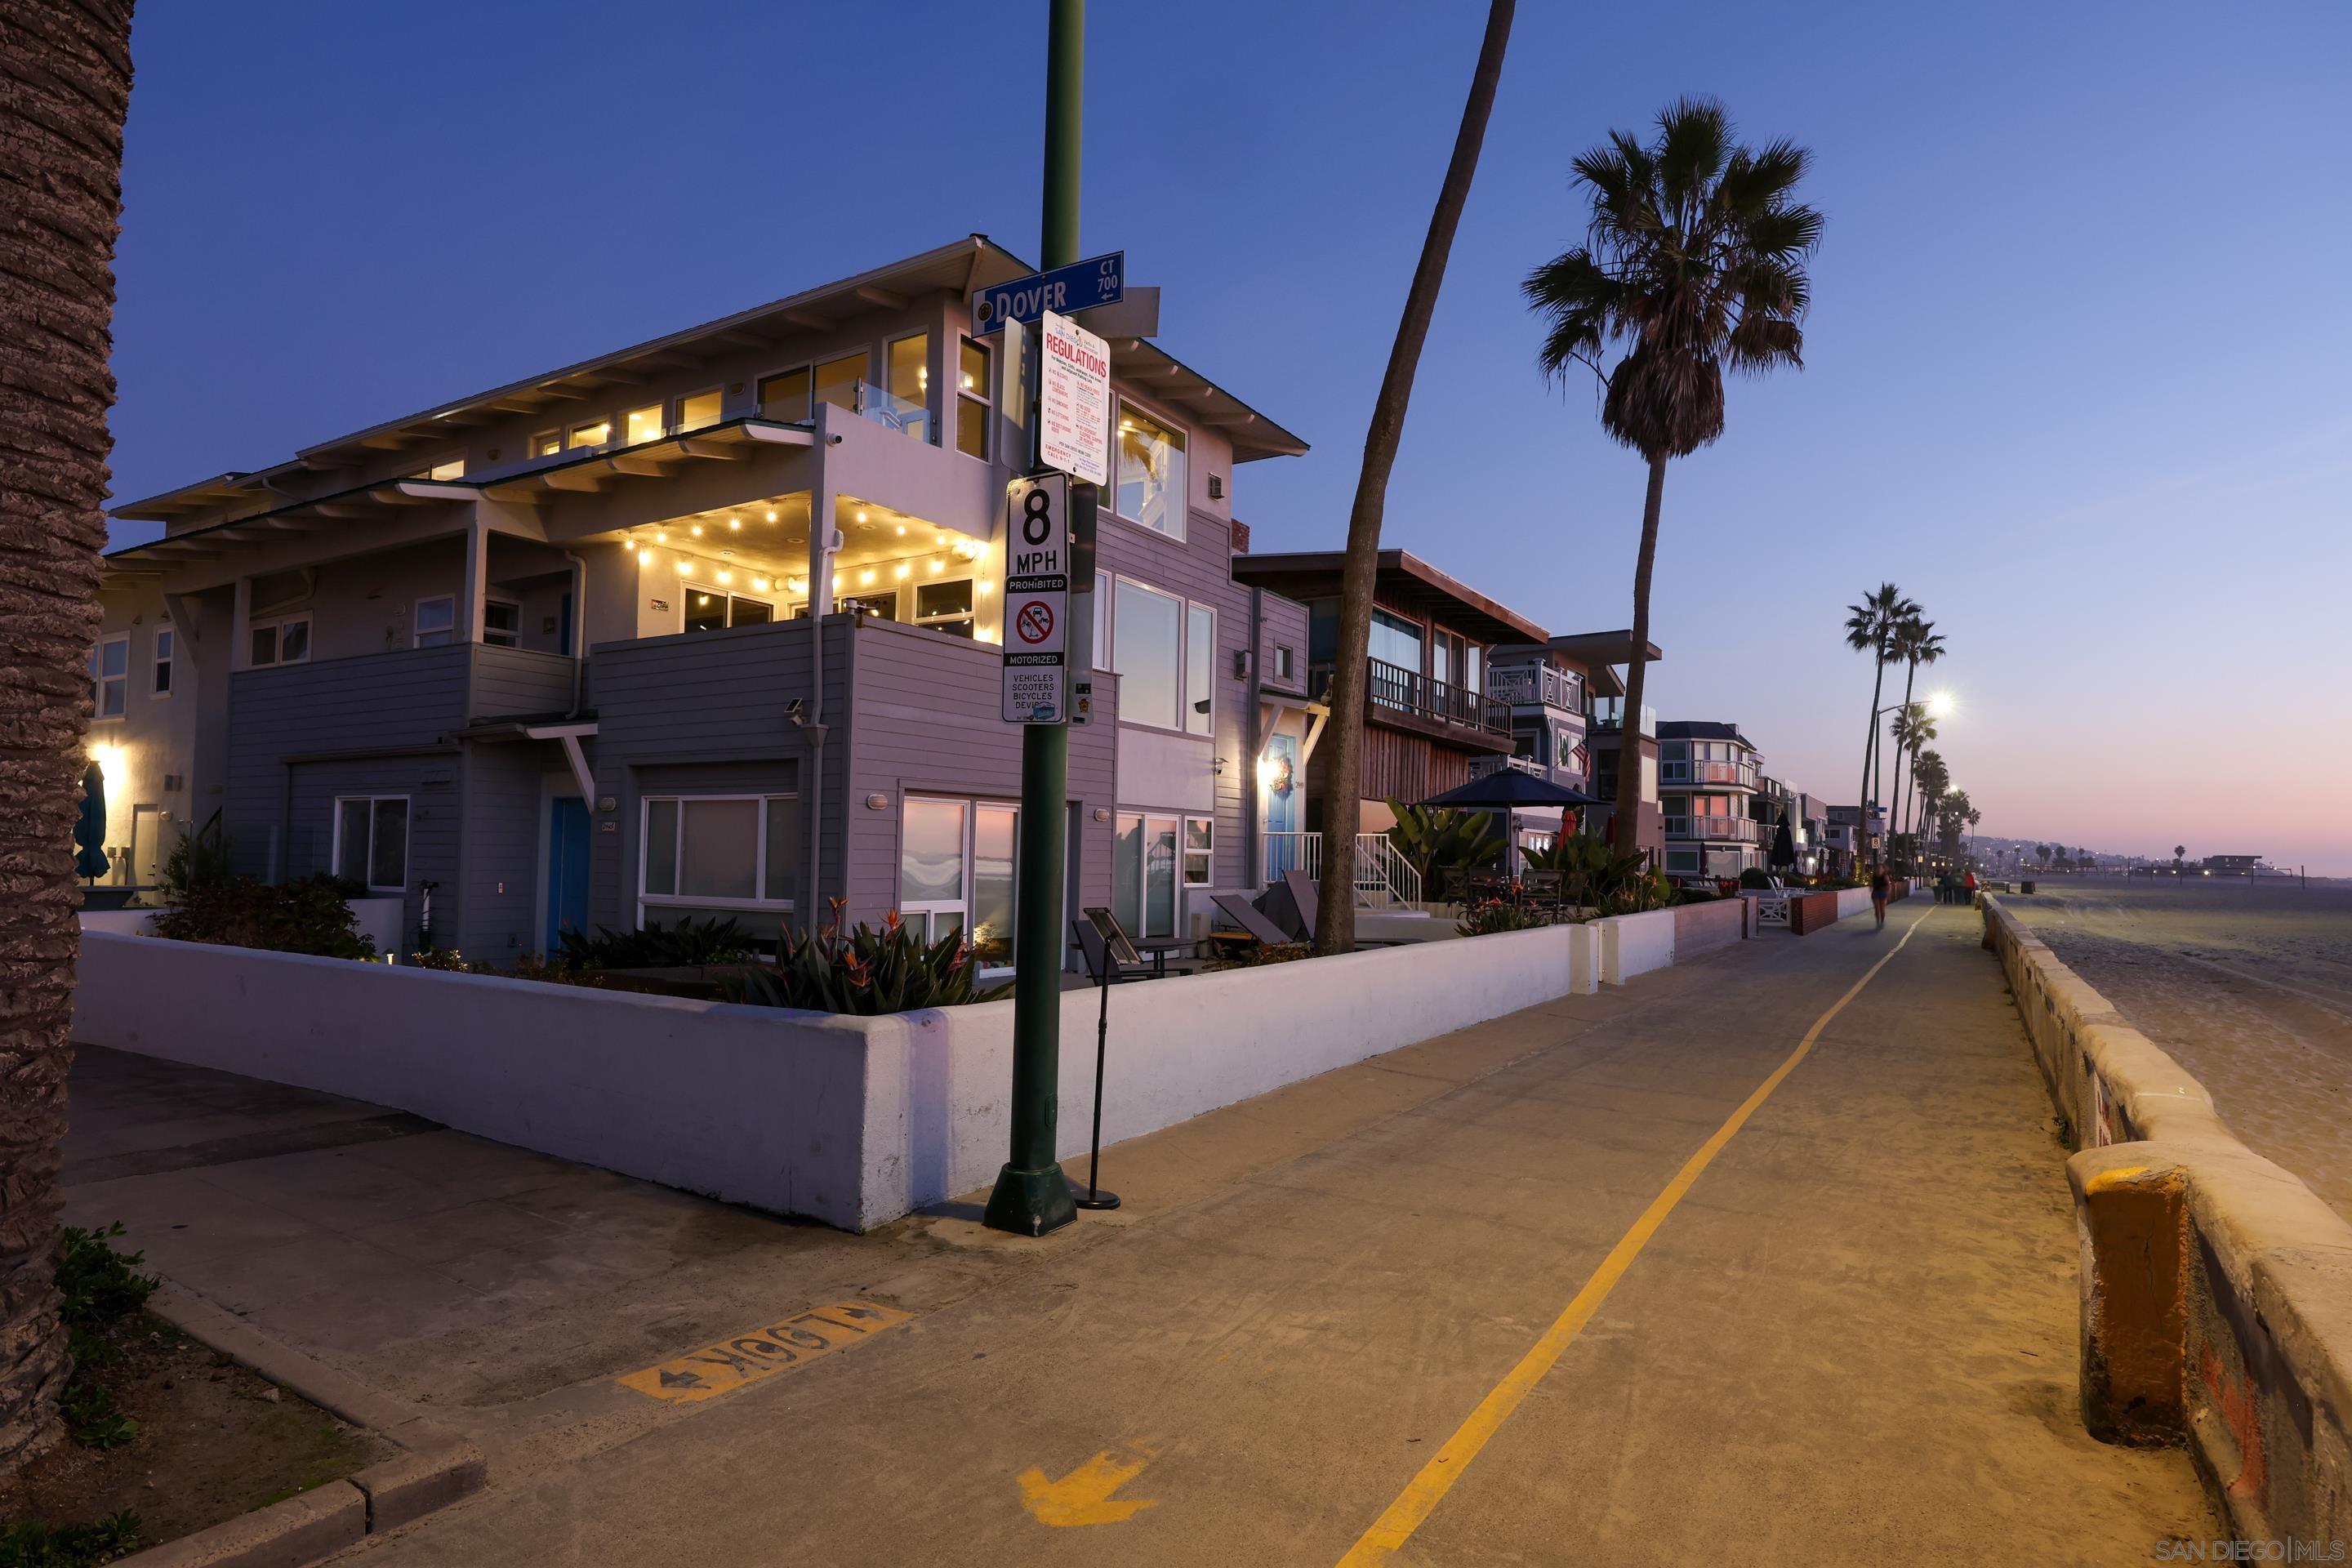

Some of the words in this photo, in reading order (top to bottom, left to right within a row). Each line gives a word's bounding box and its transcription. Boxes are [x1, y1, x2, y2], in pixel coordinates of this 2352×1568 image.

[1100, 259, 1114, 274] CT
[1098, 274, 1118, 292] 700
[996, 281, 1067, 323] DOVER
[1046, 332, 1107, 378] REGULATIONS
[1045, 443, 1071, 458] EMERGENCY
[1047, 451, 1058, 459] CALL
[1022, 488, 1050, 546] 8
[1017, 550, 1057, 575] MPH
[1009, 579, 1063, 590] PROHIBITED
[1009, 655, 1058, 665] MOTORIZED
[1013, 674, 1054, 682] VEHICLES
